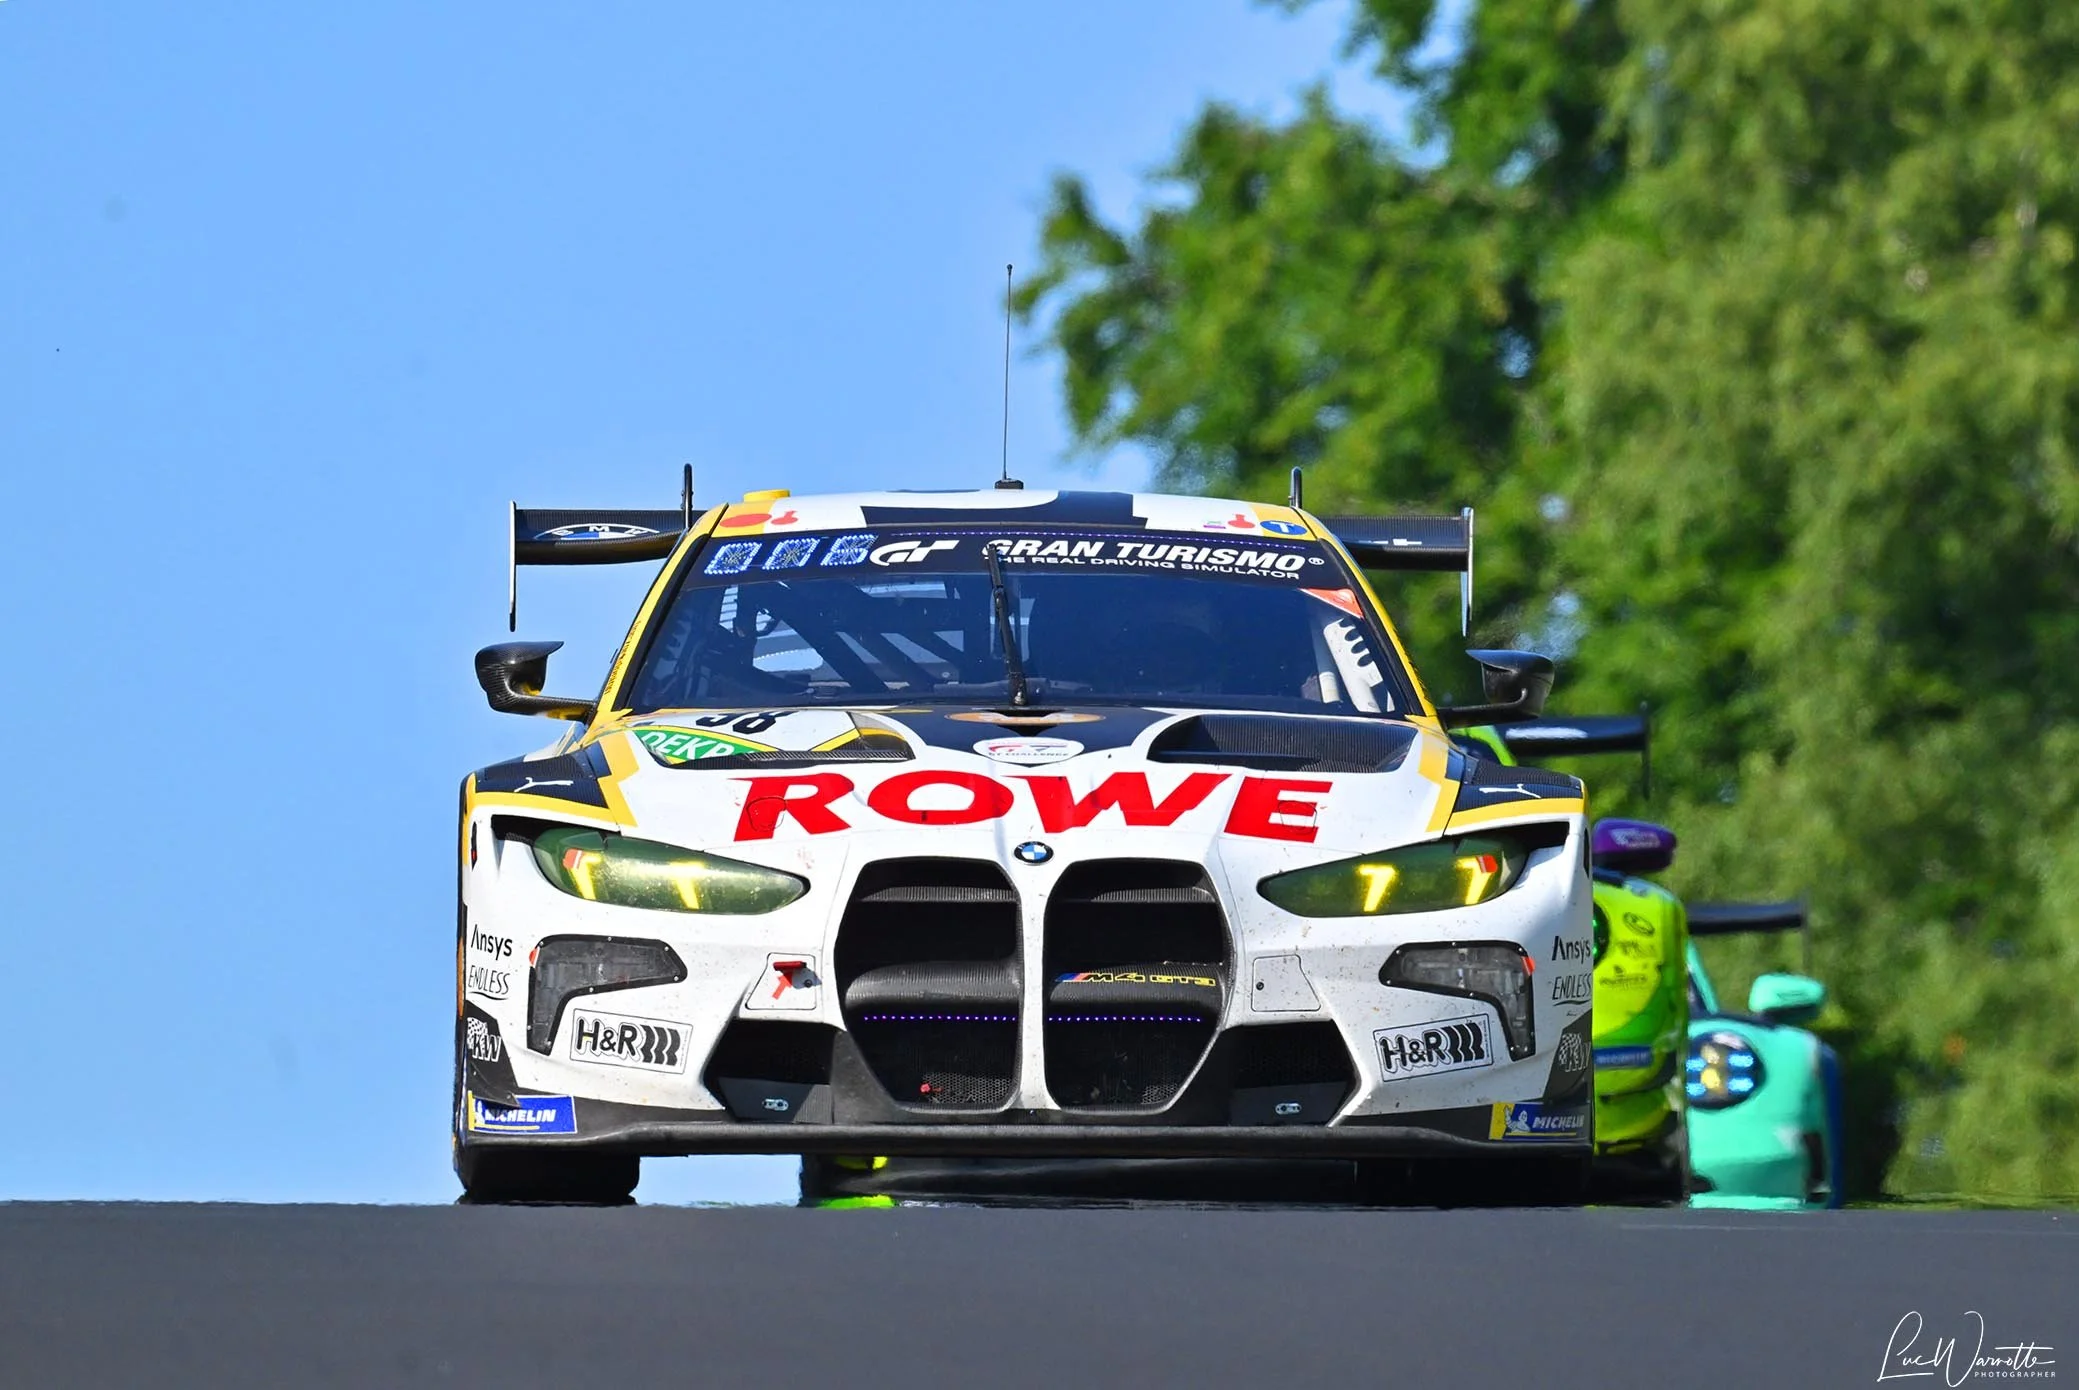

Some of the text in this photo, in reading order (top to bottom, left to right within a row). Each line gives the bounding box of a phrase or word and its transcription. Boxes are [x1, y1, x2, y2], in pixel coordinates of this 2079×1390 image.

[981, 539, 1105, 557] GRAN
[1032, 556, 1086, 564] REAL
[1091, 558, 1175, 569] DRIVING
[1181, 563, 1300, 580] SIMULATOR
[727, 770, 1333, 842] ROWE
[470, 924, 513, 961] Ansys
[1551, 935, 1591, 965] Ansys
[467, 964, 511, 996] ENDLESS
[472, 1033, 502, 1063] KW
[576, 1017, 640, 1058] H&R
[1378, 1030, 1446, 1071] H&R
